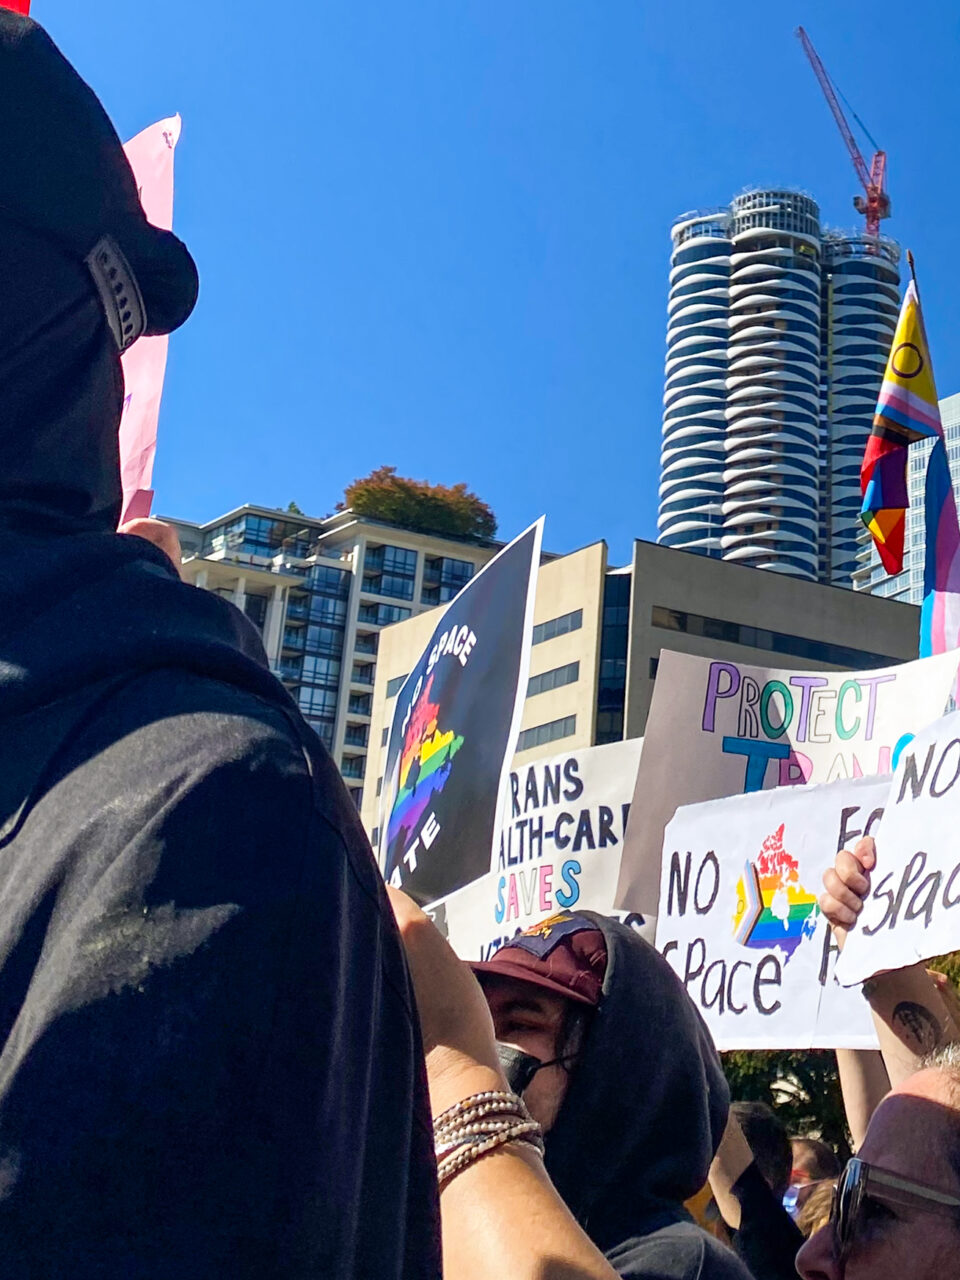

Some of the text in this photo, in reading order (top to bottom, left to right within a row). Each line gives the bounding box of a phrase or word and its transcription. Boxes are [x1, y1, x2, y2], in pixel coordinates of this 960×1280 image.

[425, 624, 478, 674] SPACE
[701, 660, 897, 744] PROTECT
[509, 757, 585, 819] RANS
[384, 811, 441, 891] ATE
[667, 850, 721, 917] NO
[494, 859, 583, 926] SAVES
